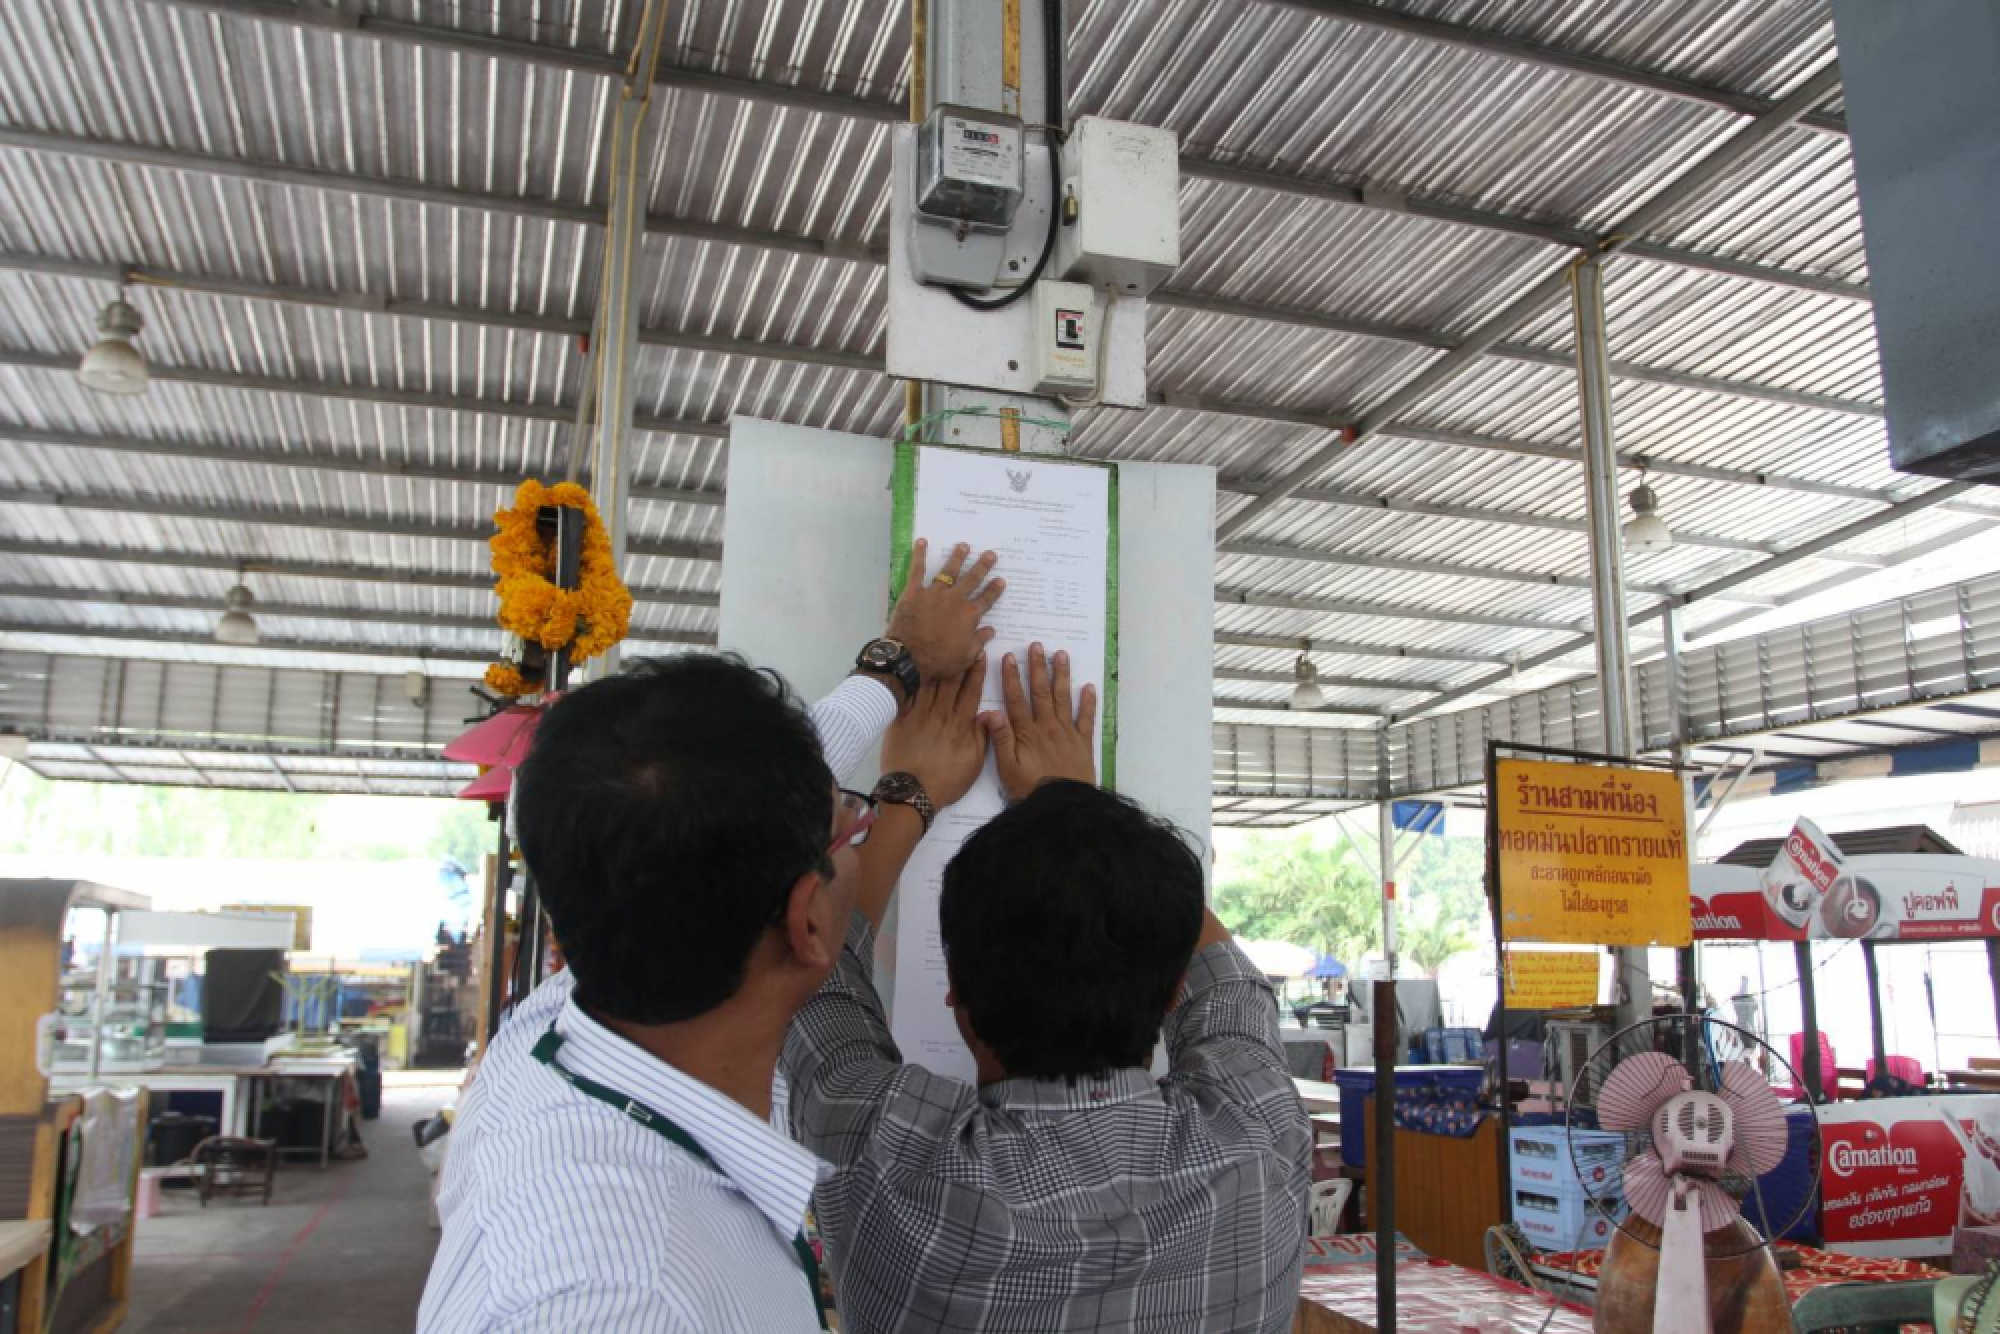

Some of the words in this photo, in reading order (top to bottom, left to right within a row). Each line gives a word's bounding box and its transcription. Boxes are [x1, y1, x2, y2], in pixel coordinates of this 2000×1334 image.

[1517, 775, 1657, 816] ร้านสามพี่น้อง
[1499, 824, 1681, 859] ทอดมันปลากรายแท้
[1829, 1140, 1917, 1177] Carnation
